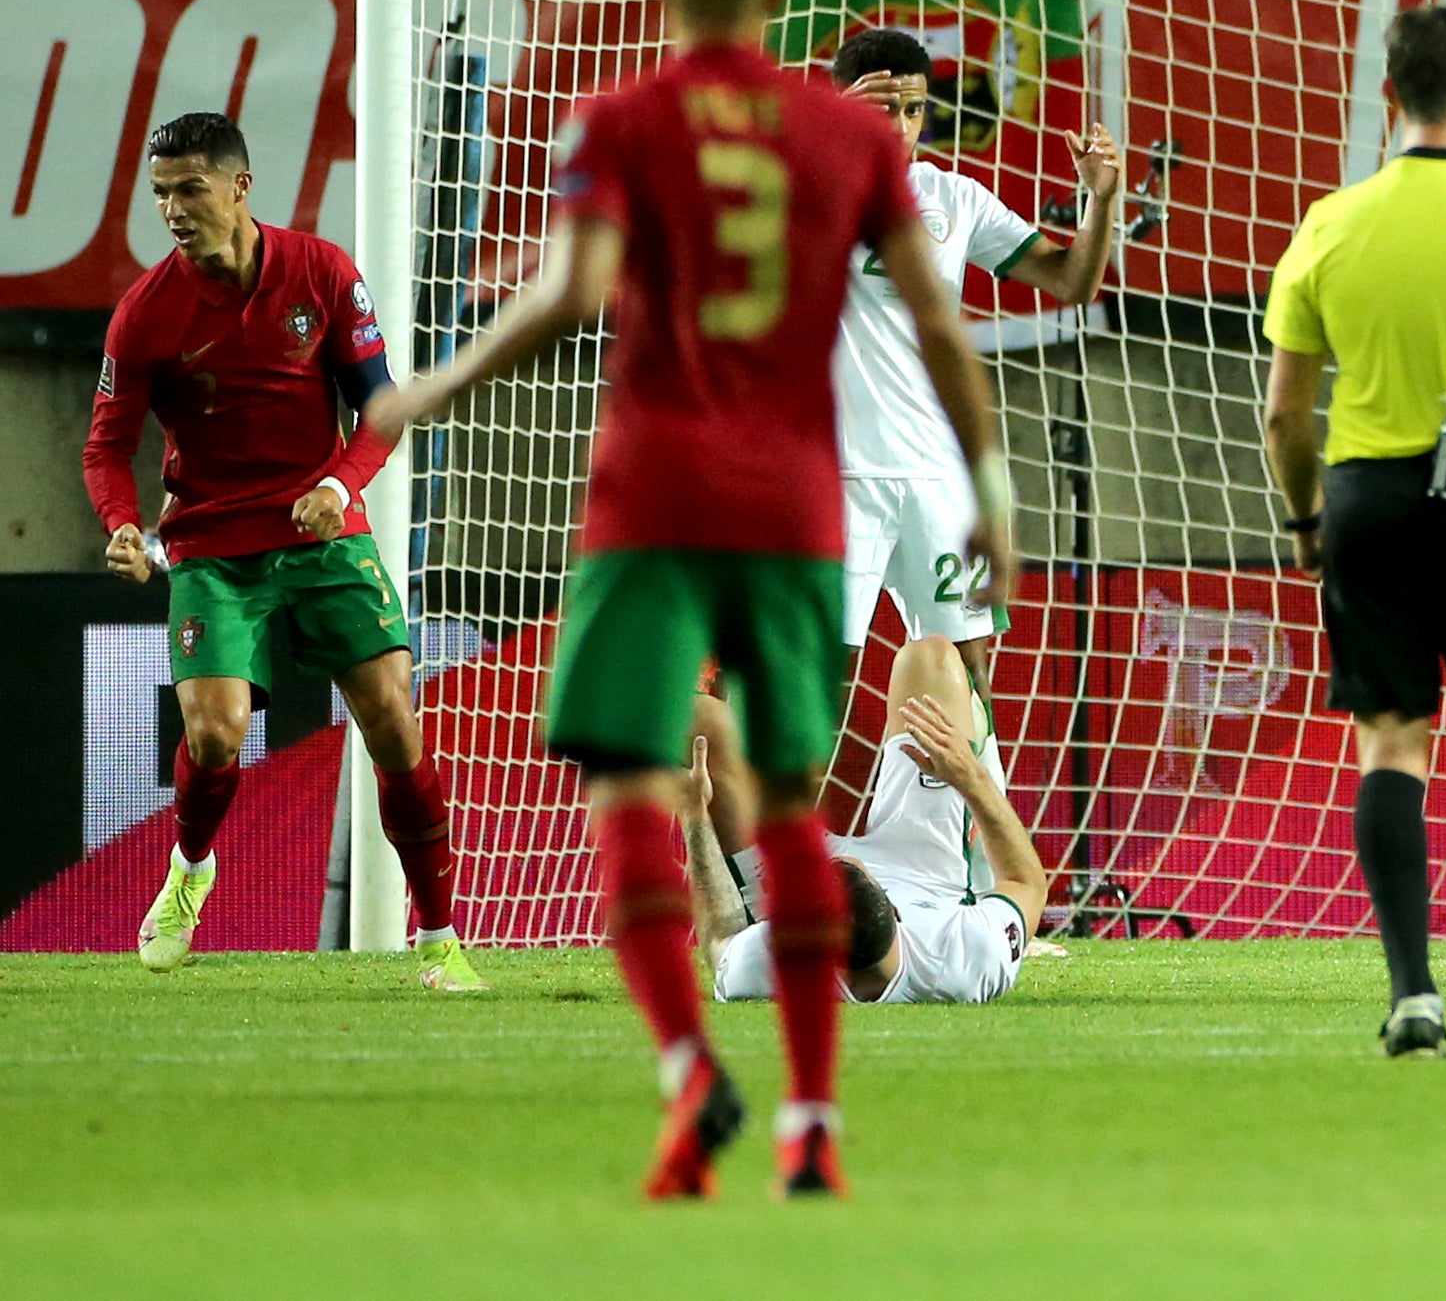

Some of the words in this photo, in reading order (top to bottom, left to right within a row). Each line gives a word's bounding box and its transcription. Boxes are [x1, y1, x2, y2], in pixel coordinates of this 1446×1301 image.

[698, 139, 788, 342] 3
[358, 558, 391, 604] 7
[934, 552, 989, 603] 22
